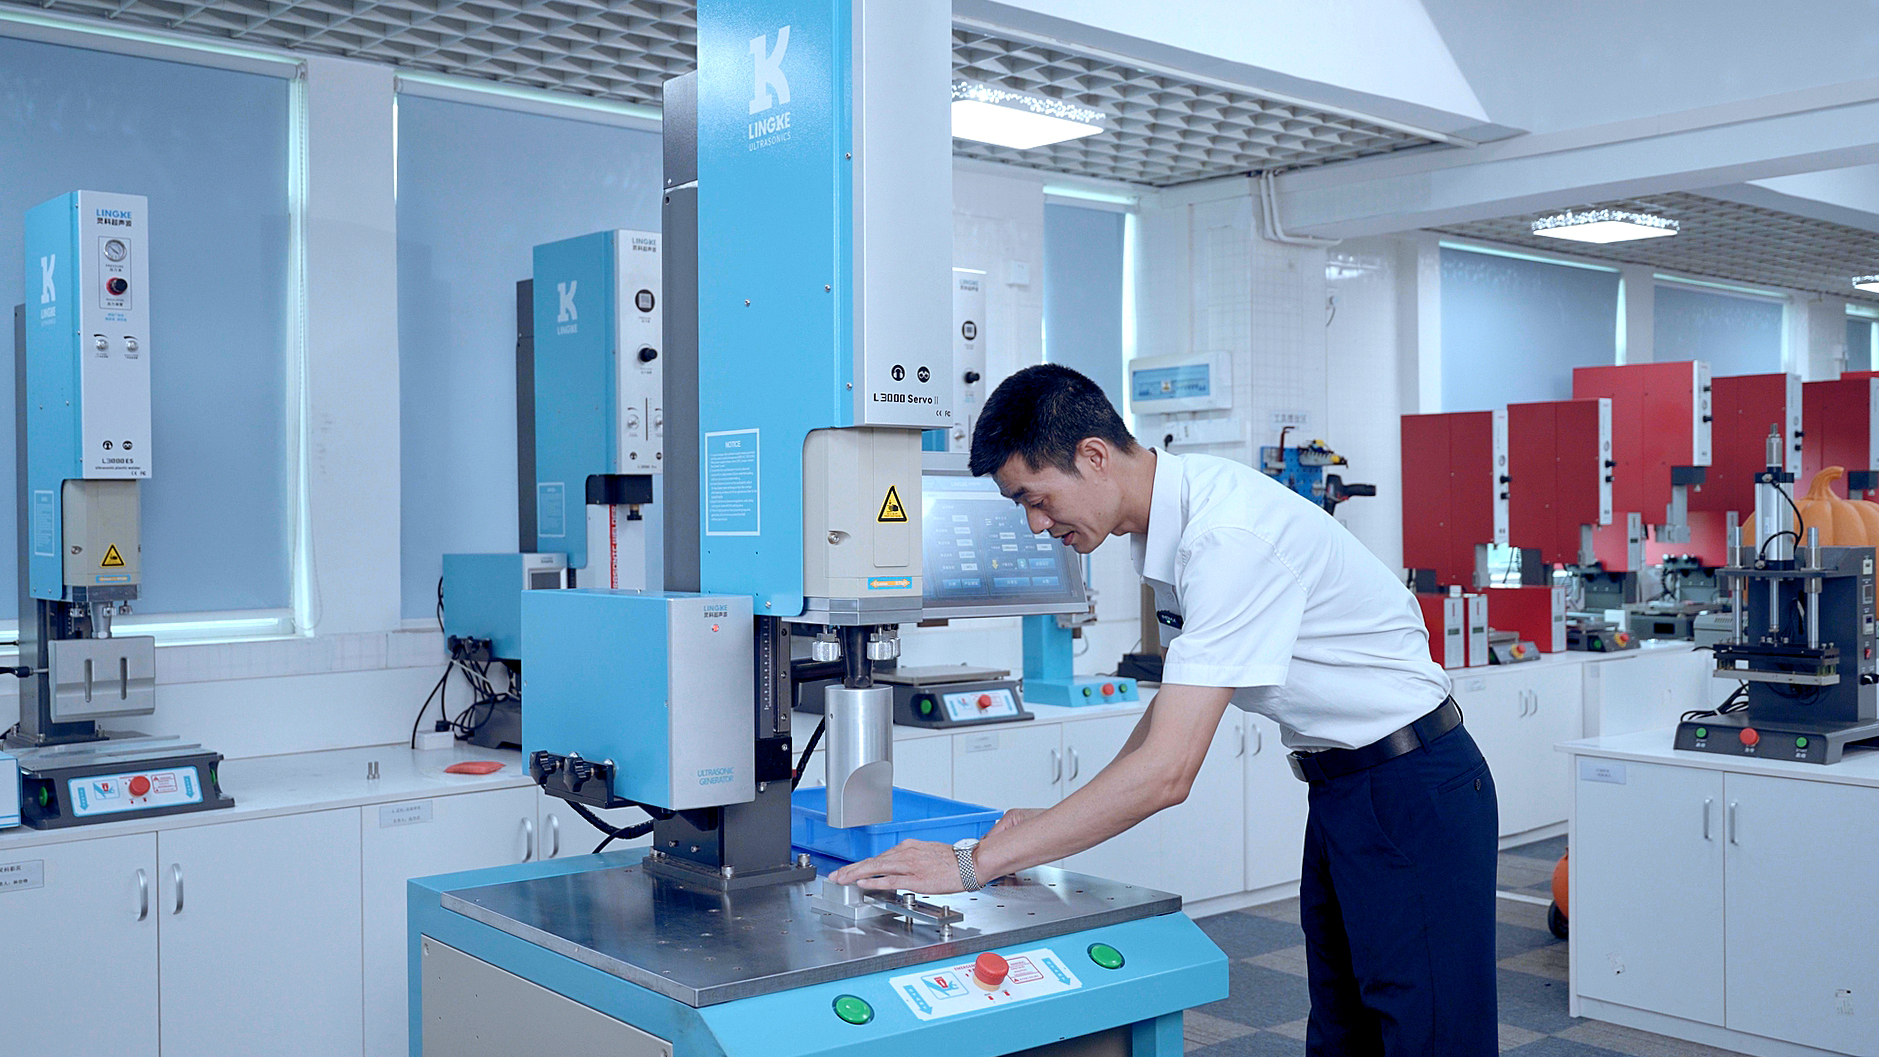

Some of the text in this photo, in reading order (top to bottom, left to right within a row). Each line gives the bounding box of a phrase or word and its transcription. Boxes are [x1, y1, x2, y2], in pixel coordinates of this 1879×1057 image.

[748, 111, 791, 140] LINGKE
[748, 131, 791, 152] ULTRASONICS
[96, 209, 132, 219] LINGKE
[632, 237, 657, 246] LINGKE
[41, 306, 56, 319] LINGKE
[557, 324, 578, 335] LINGKE
[907, 394, 933, 405] Servo
[725, 440, 741, 448] NOTICE
[697, 767, 734, 778] ULTRASONIC
[699, 775, 734, 786] GENERATOR
